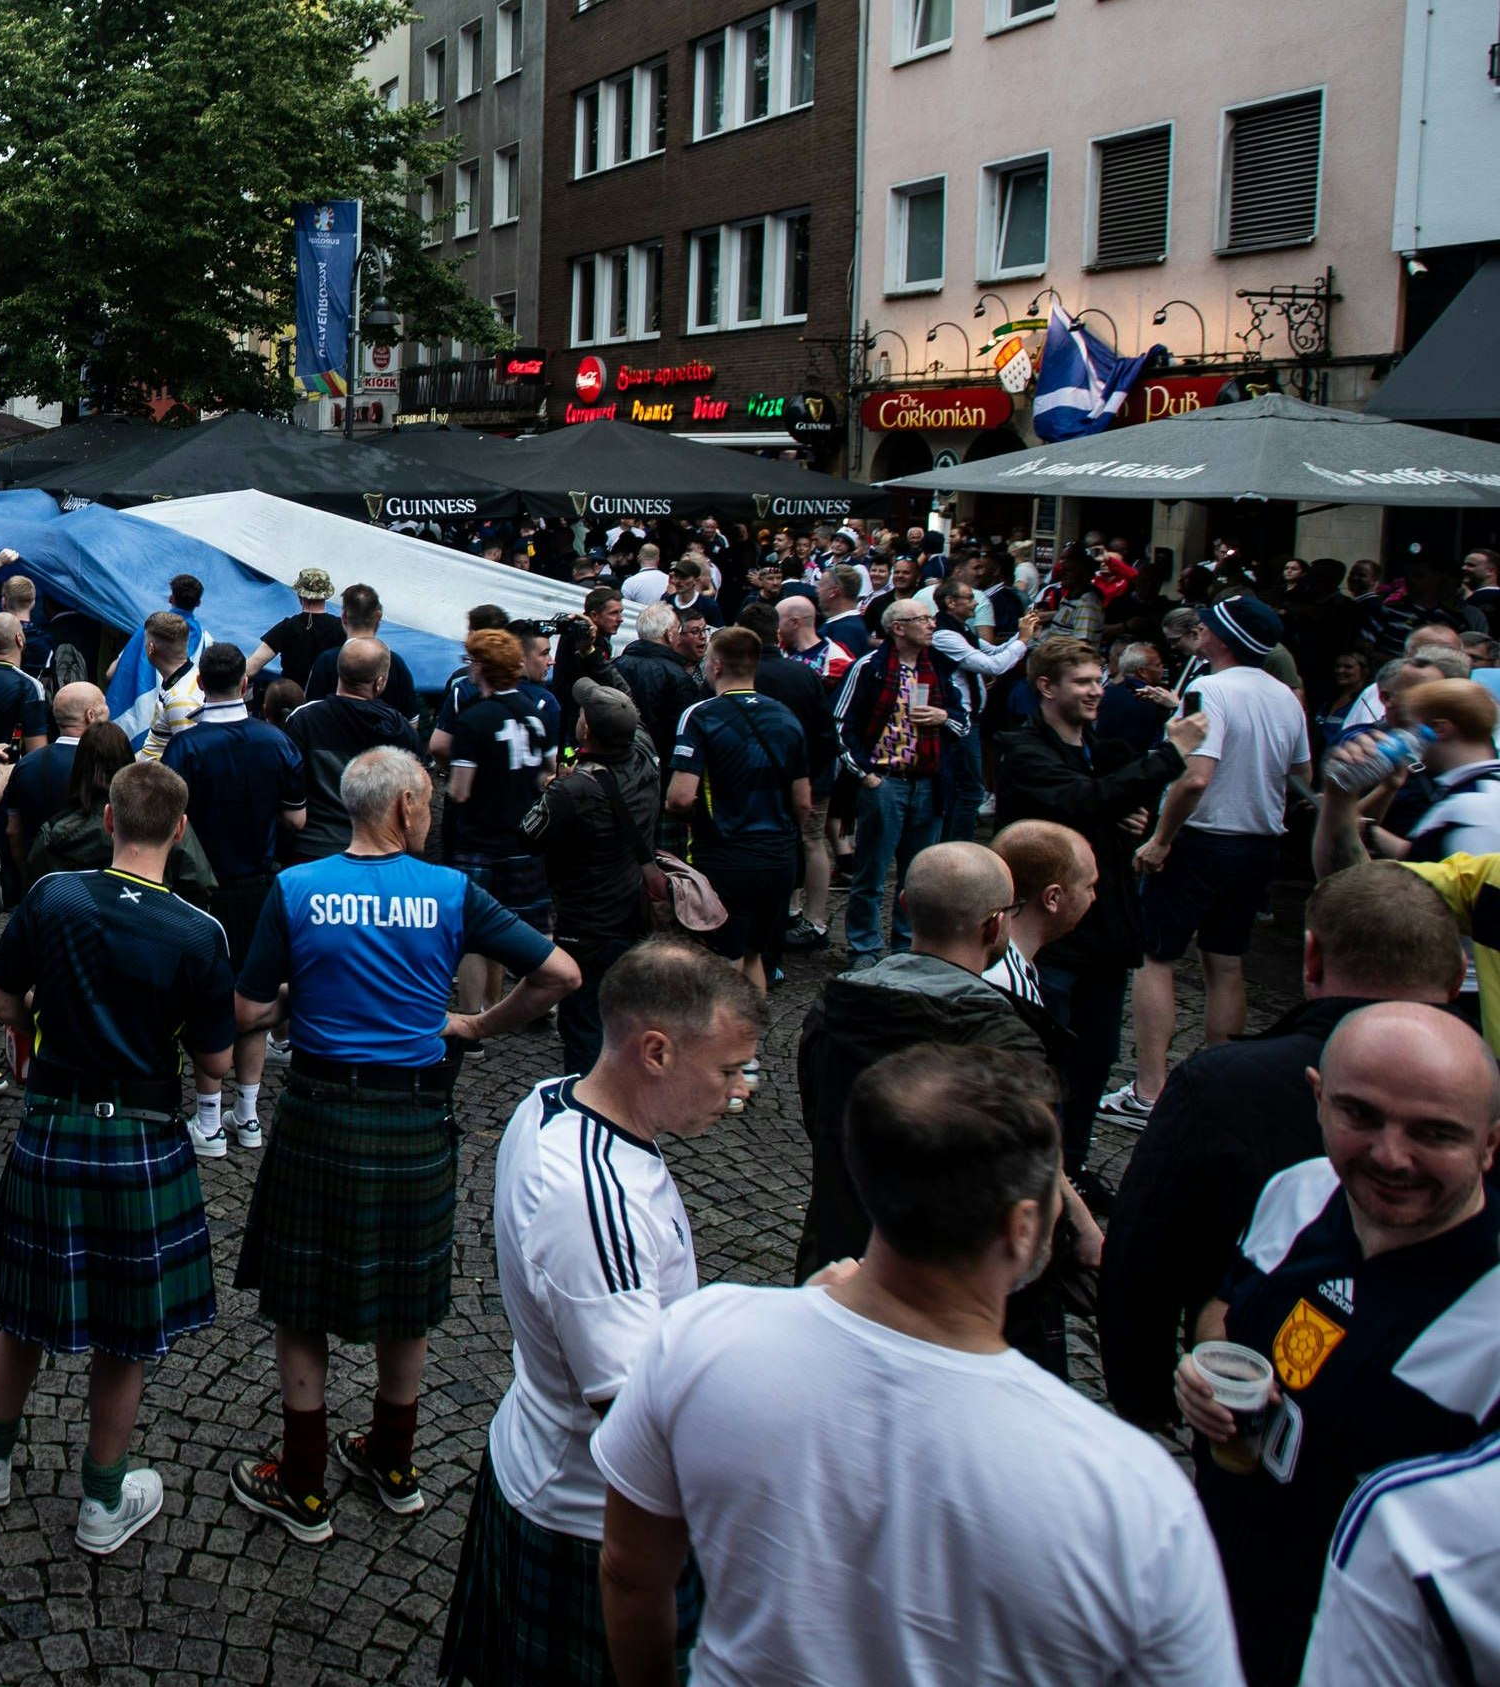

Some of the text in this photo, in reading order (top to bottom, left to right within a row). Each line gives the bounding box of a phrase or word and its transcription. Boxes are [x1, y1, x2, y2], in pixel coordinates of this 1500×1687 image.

[364, 377, 397, 388] KIOSK
[653, 359, 713, 387] appetito
[565, 392, 785, 424] Currywurst Pommes Döner Pizza
[879, 398, 987, 429] Corkonian
[899, 393, 919, 408] The
[386, 497, 477, 516] GUINNESS
[589, 495, 672, 515] GUINNESS
[772, 497, 852, 516] GUINNESS
[494, 715, 547, 770] 10
[309, 893, 438, 929] SCOTLAND
[1317, 1283, 1355, 1316] adidas
